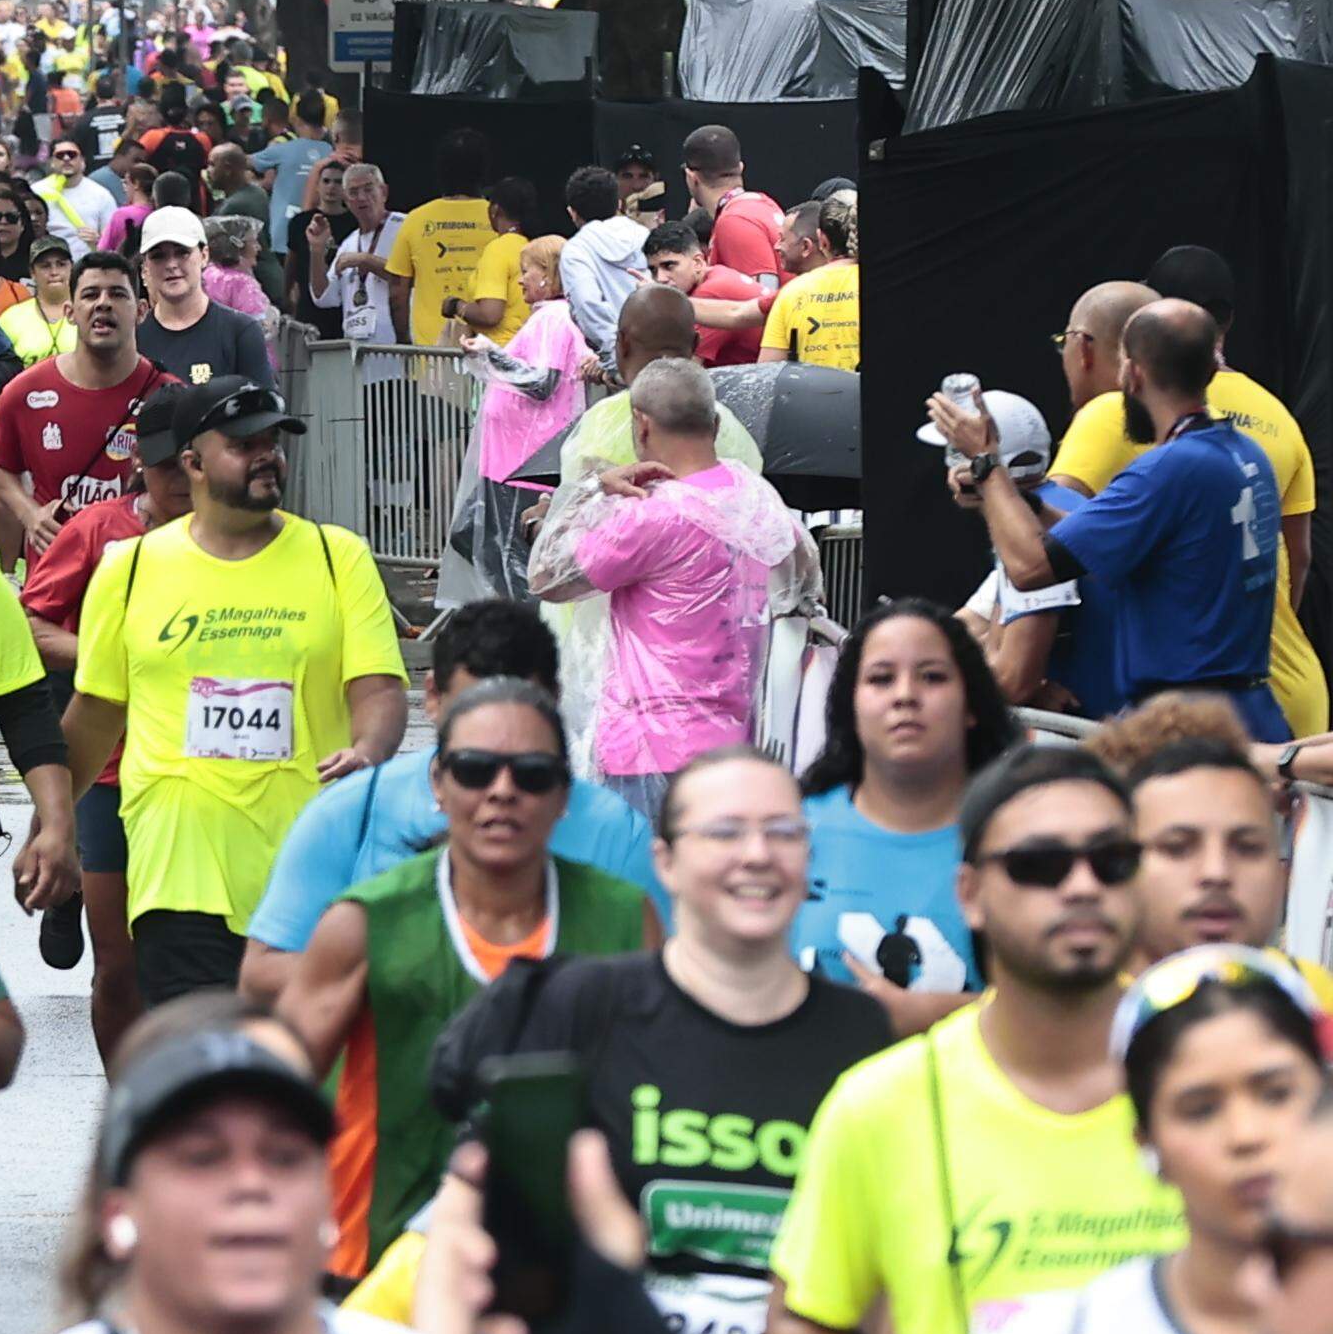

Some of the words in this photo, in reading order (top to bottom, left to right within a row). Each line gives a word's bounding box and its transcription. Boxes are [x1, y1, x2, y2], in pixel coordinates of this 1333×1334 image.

[203, 606, 307, 624] S.Magalhães
[197, 625, 283, 642] Essemaga
[203, 706, 281, 732] 17044
